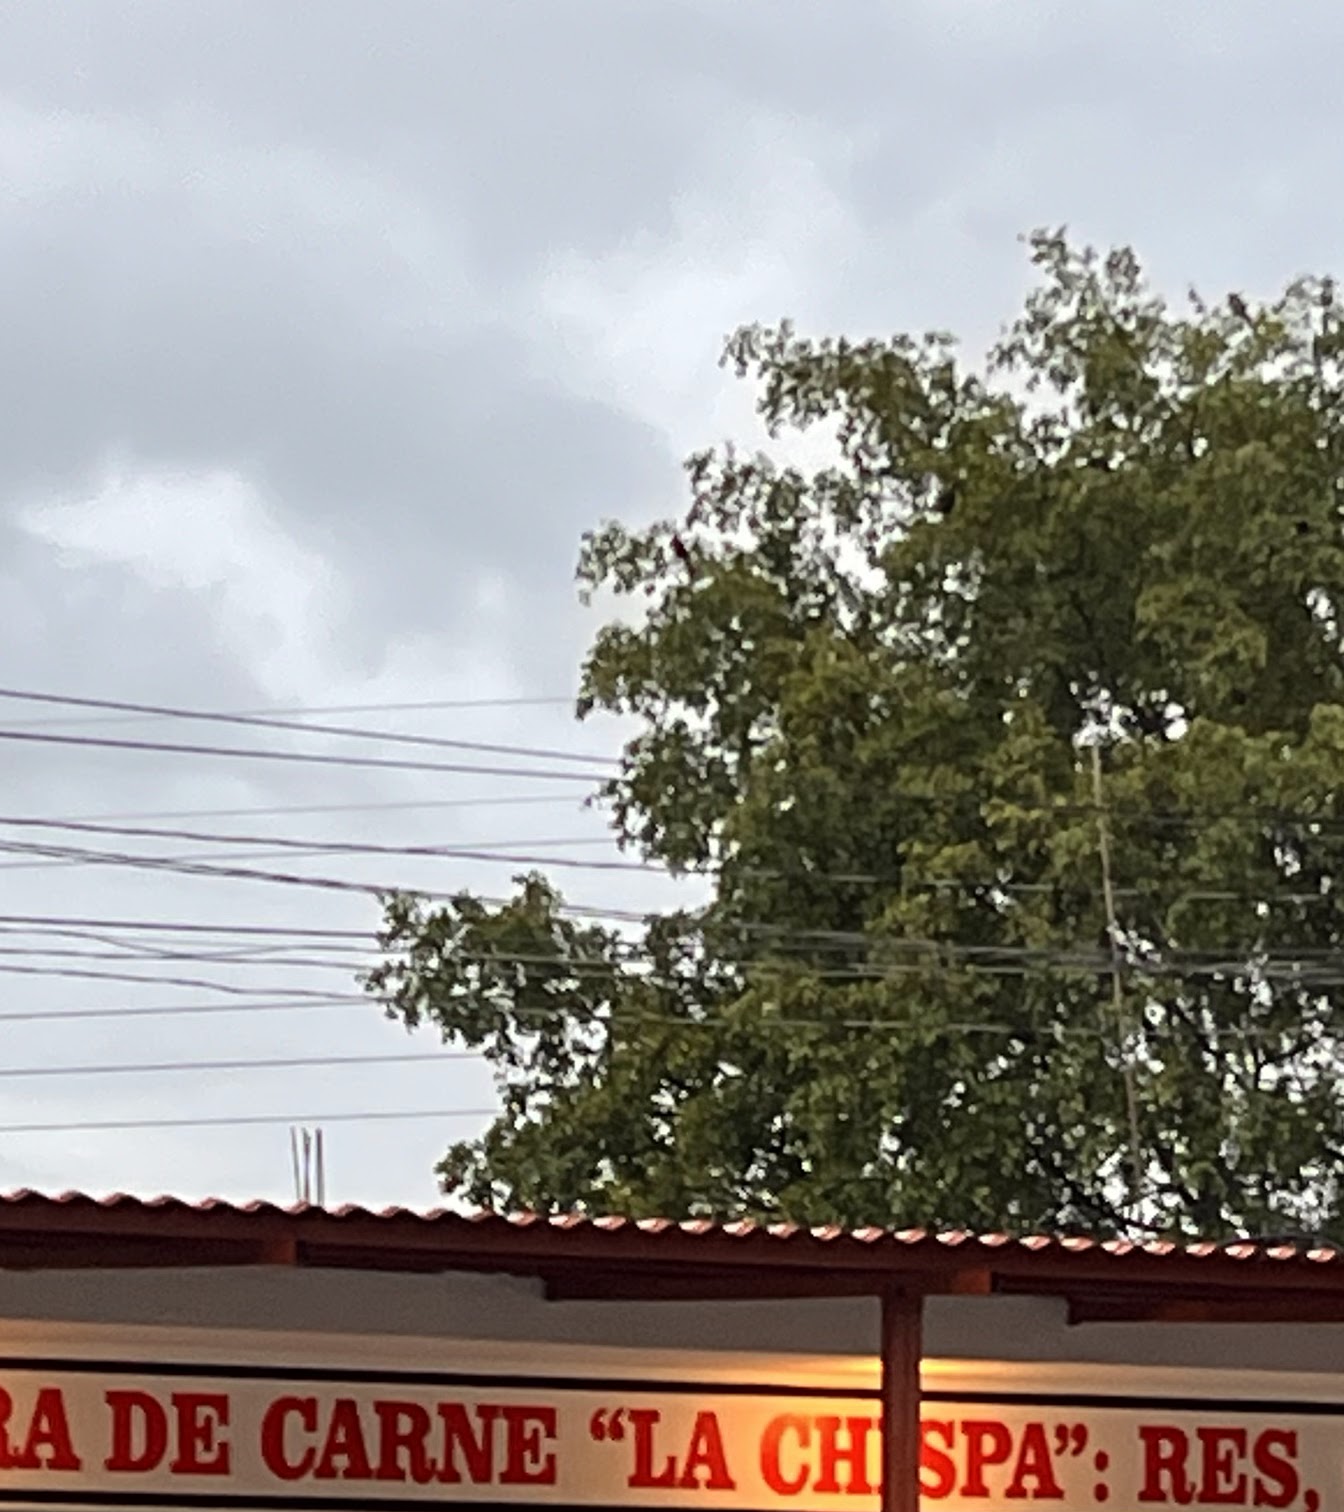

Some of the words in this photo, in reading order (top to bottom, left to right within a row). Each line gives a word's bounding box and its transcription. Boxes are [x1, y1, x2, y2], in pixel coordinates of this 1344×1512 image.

[104, 1389, 230, 1475] DE
[261, 1396, 559, 1486] CARNE
[760, 1413, 1110, 1503] CHSPA”:
